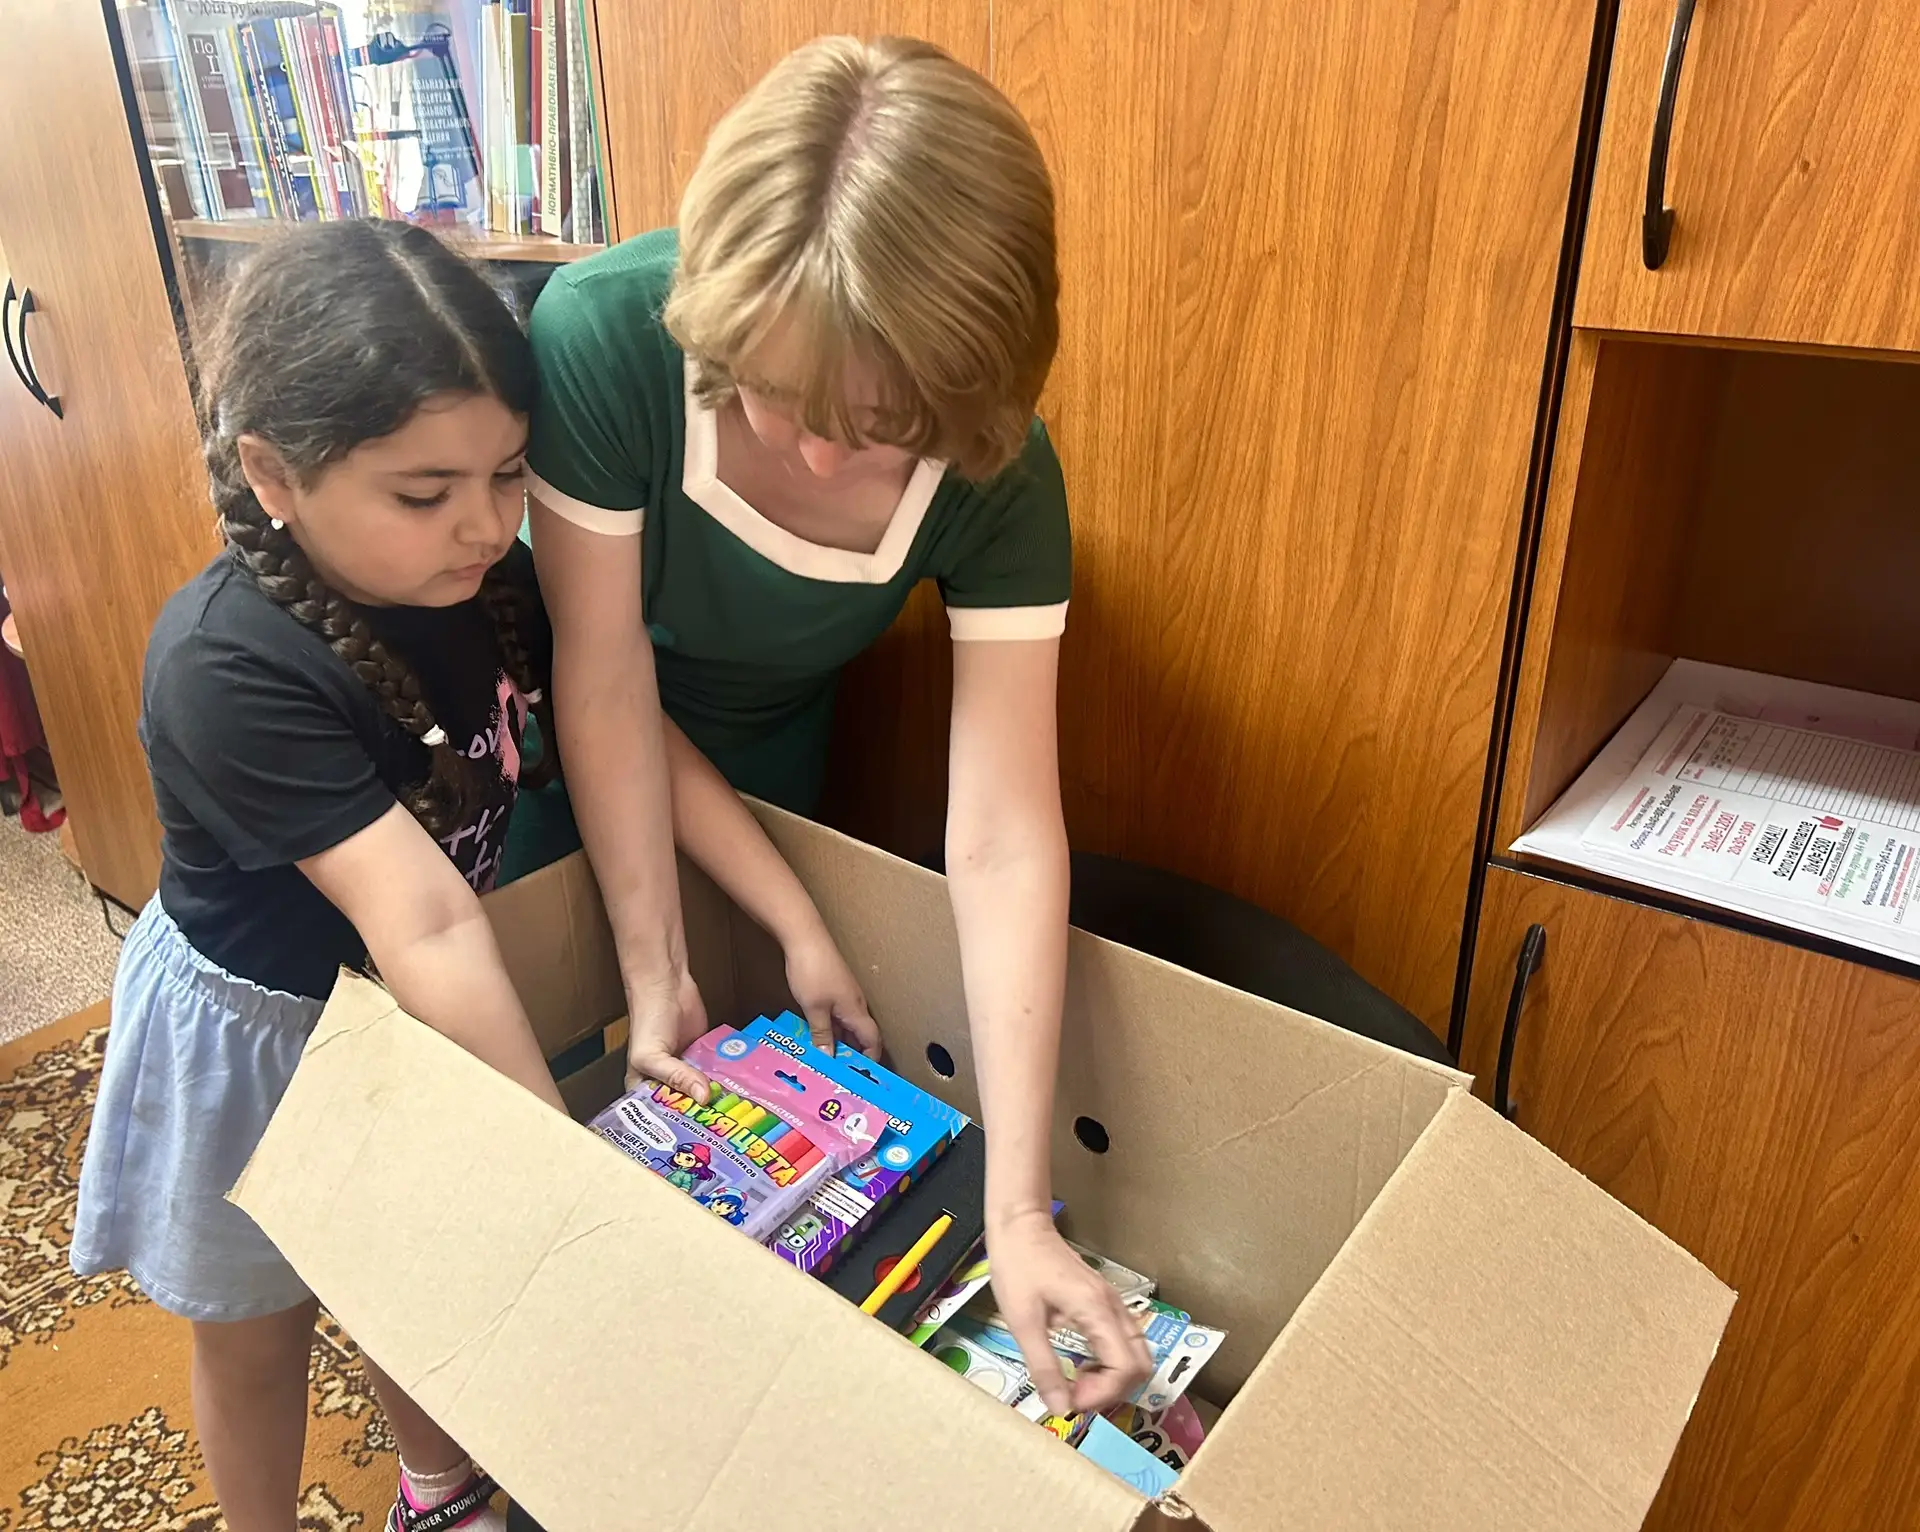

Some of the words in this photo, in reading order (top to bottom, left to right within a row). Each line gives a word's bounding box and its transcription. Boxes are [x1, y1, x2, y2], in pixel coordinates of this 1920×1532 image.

[548, 69, 557, 216] НОРМАТИВНО-ПРАВОВАЯ
[1686, 793, 1709, 818] холсте
[1679, 816, 1694, 826] на
[1657, 825, 1689, 857] Рисунок
[1750, 823, 1783, 863] НОВИНКА!!!
[1789, 820, 1813, 850] металле
[1784, 849, 1799, 860] на
[1772, 859, 1794, 877] Фото
[766, 1028, 806, 1056] набор
[724, 1078, 750, 1097] НАБОР
[621, 1106, 663, 1145] ФЛОМАСТЕРОМ!
[626, 1101, 652, 1126] ПРОВЕДИ
[825, 1101, 839, 1115] 12
[854, 1117, 861, 1127] 1
[622, 1133, 648, 1153] ЦВЕТА
[651, 1083, 738, 1137] МАГИЯ
[727, 1126, 798, 1187] ЦВЕТА
[662, 1111, 679, 1123] ДЛЯ
[681, 1121, 706, 1139] ЮНЫХ
[706, 1136, 757, 1178] ВОЛШЕБНИКОВ
[636, 1152, 650, 1166] КАК
[443, 1493, 477, 1518] YOUNG
